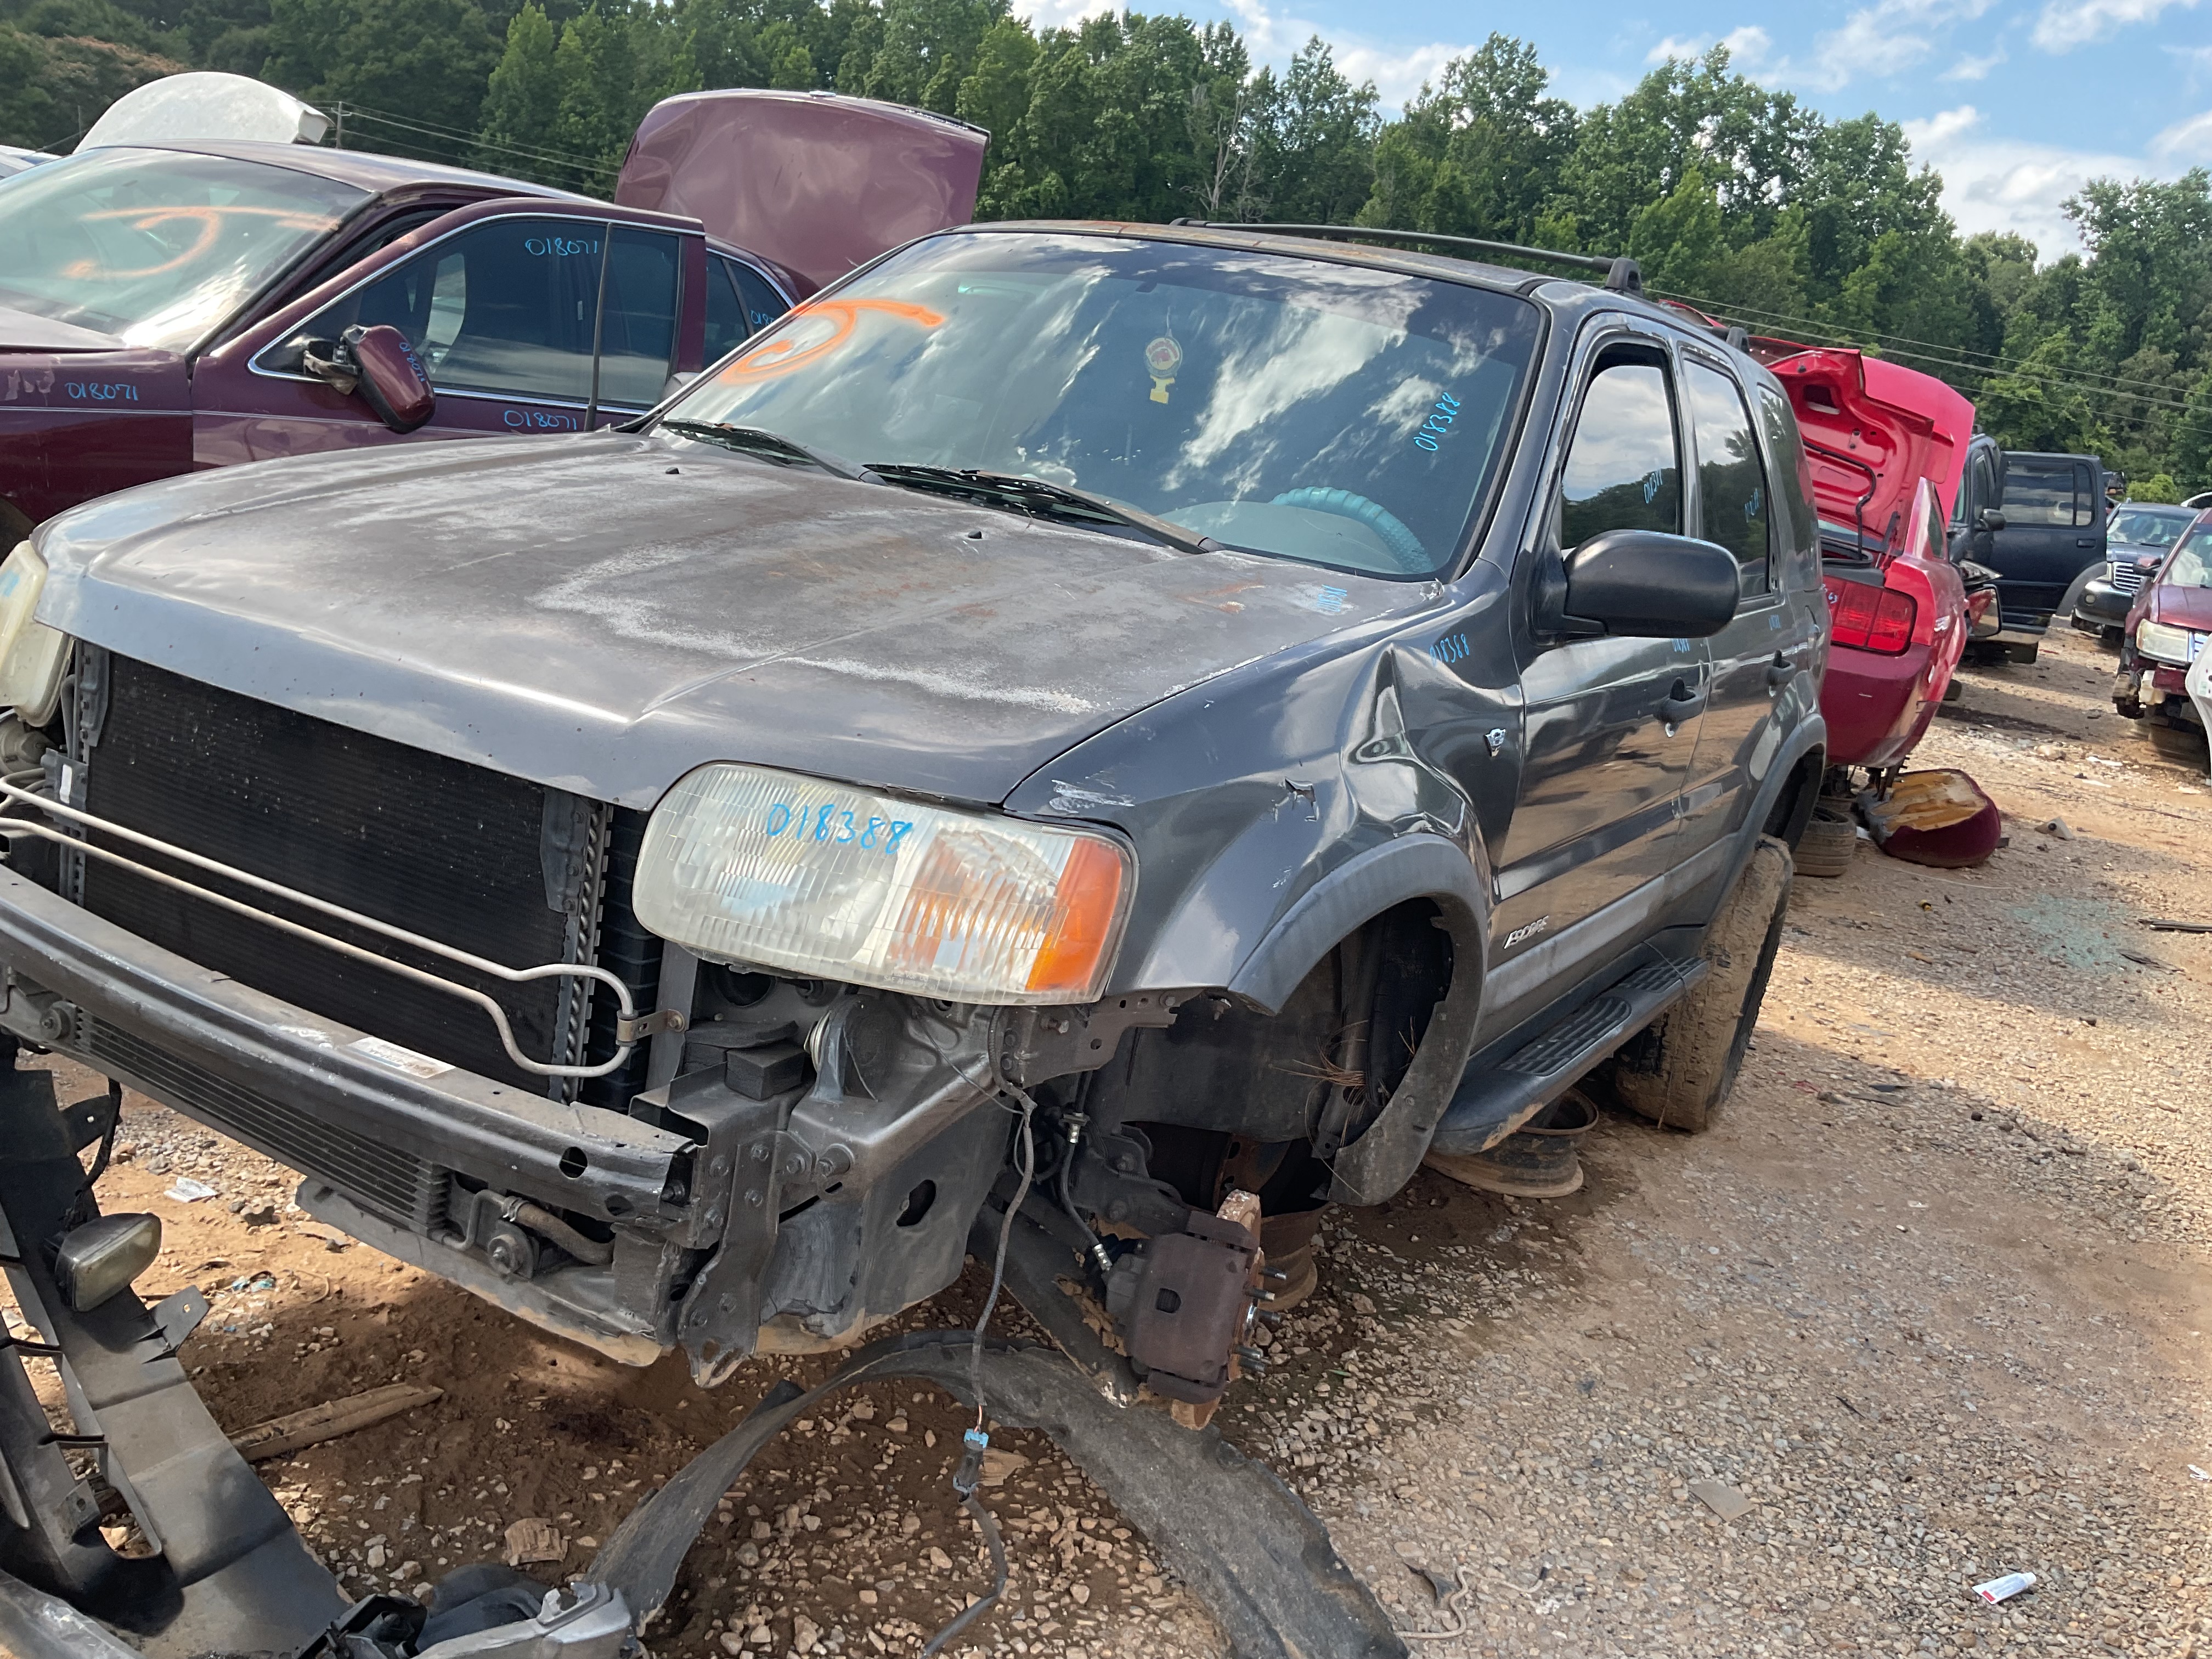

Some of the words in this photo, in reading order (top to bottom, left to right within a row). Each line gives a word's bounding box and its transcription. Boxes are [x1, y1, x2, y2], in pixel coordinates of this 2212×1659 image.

[525, 237, 597, 256] 018071
[751, 310, 775, 325] 018
[65, 382, 138, 400] 018071
[504, 410, 577, 430] 018071
[1413, 392, 1460, 451] 018388
[768, 804, 913, 854] 018388
